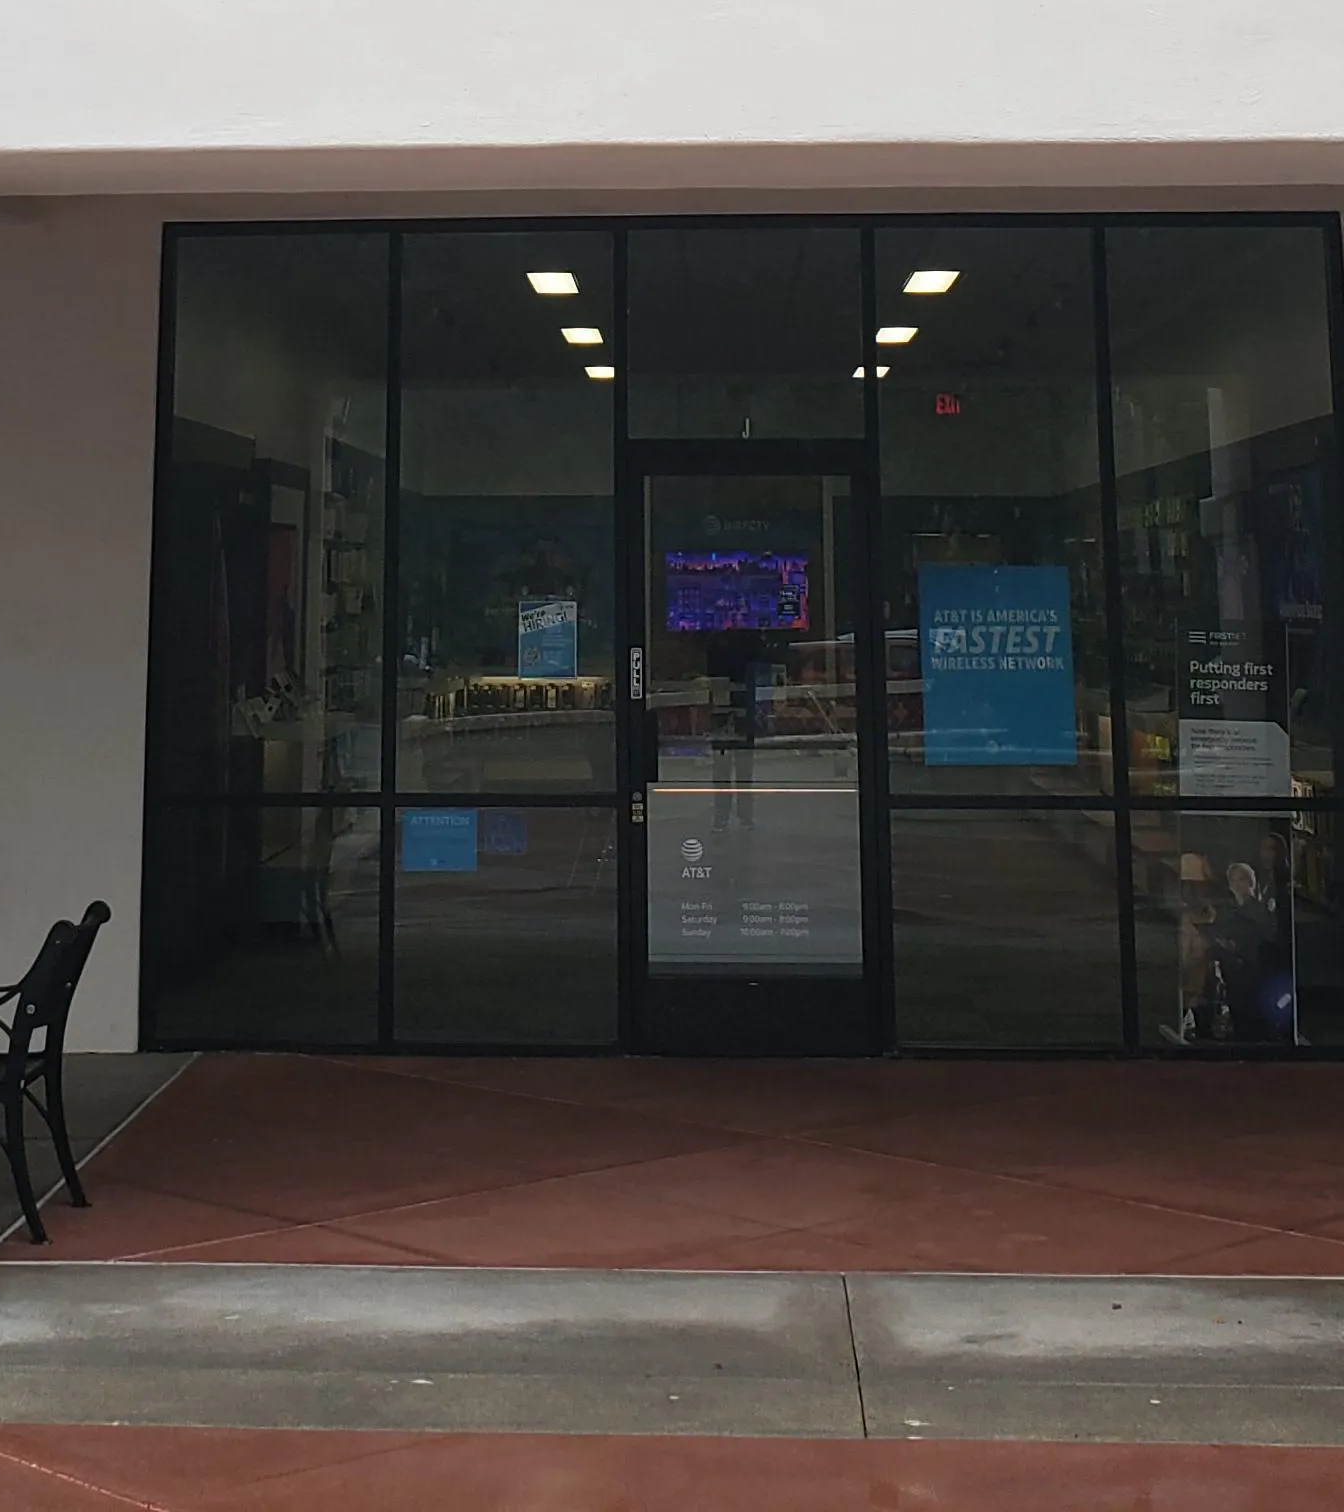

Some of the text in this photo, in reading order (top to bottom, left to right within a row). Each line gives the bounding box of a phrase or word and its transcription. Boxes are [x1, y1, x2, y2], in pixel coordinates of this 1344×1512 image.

[934, 609, 1058, 624] AT&T IS AMERICA'S
[934, 625, 1062, 654] FASTEST
[632, 652, 641, 687] PULL
[931, 656, 1065, 671] WIRELESS NETWORK
[1189, 660, 1275, 677] Putting first
[1189, 677, 1269, 692] responders
[1190, 691, 1220, 705] first
[410, 816, 471, 827] ATTENTION
[681, 867, 713, 879] AT&T
